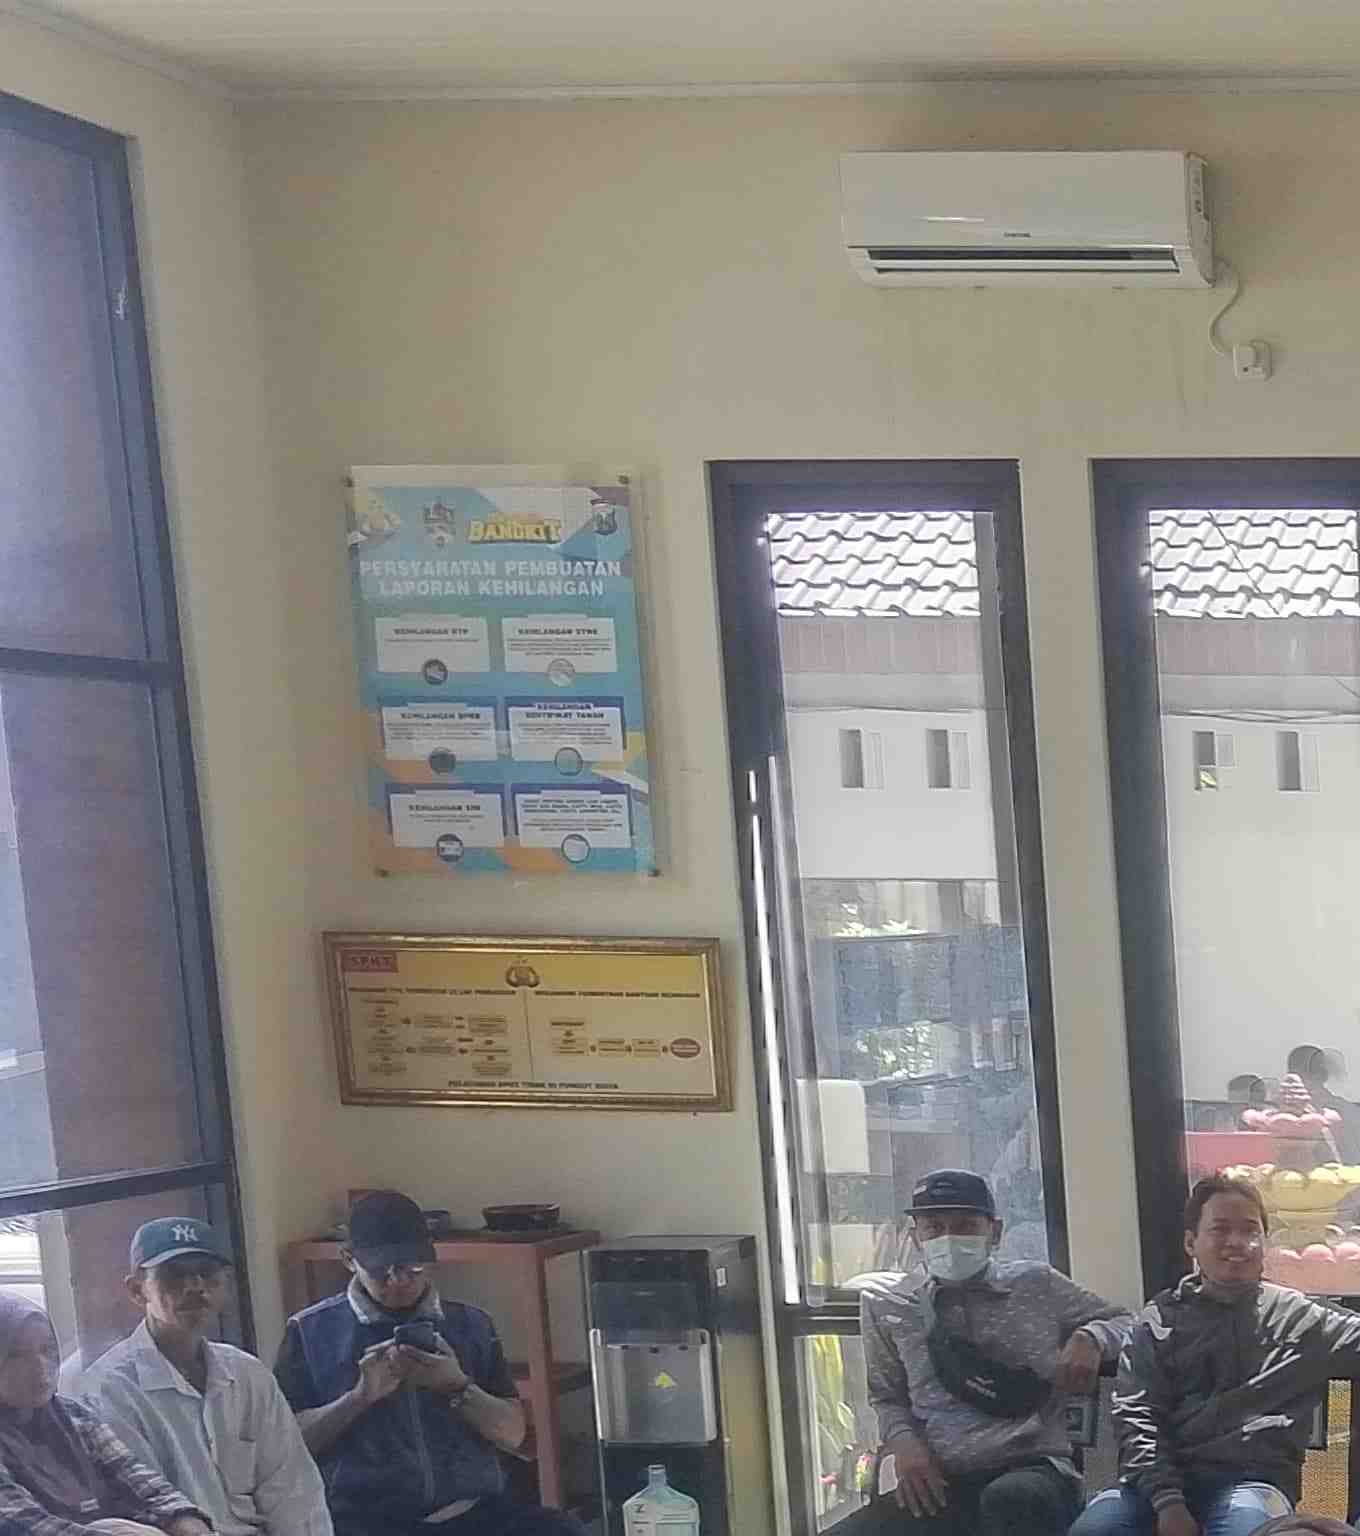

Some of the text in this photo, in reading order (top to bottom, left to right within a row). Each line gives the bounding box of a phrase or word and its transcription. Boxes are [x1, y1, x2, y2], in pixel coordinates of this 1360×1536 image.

[360, 560, 621, 576] PERSYARATAN PEMBUATAN
[379, 580, 604, 596] LAPORAN KEHILANGAN
